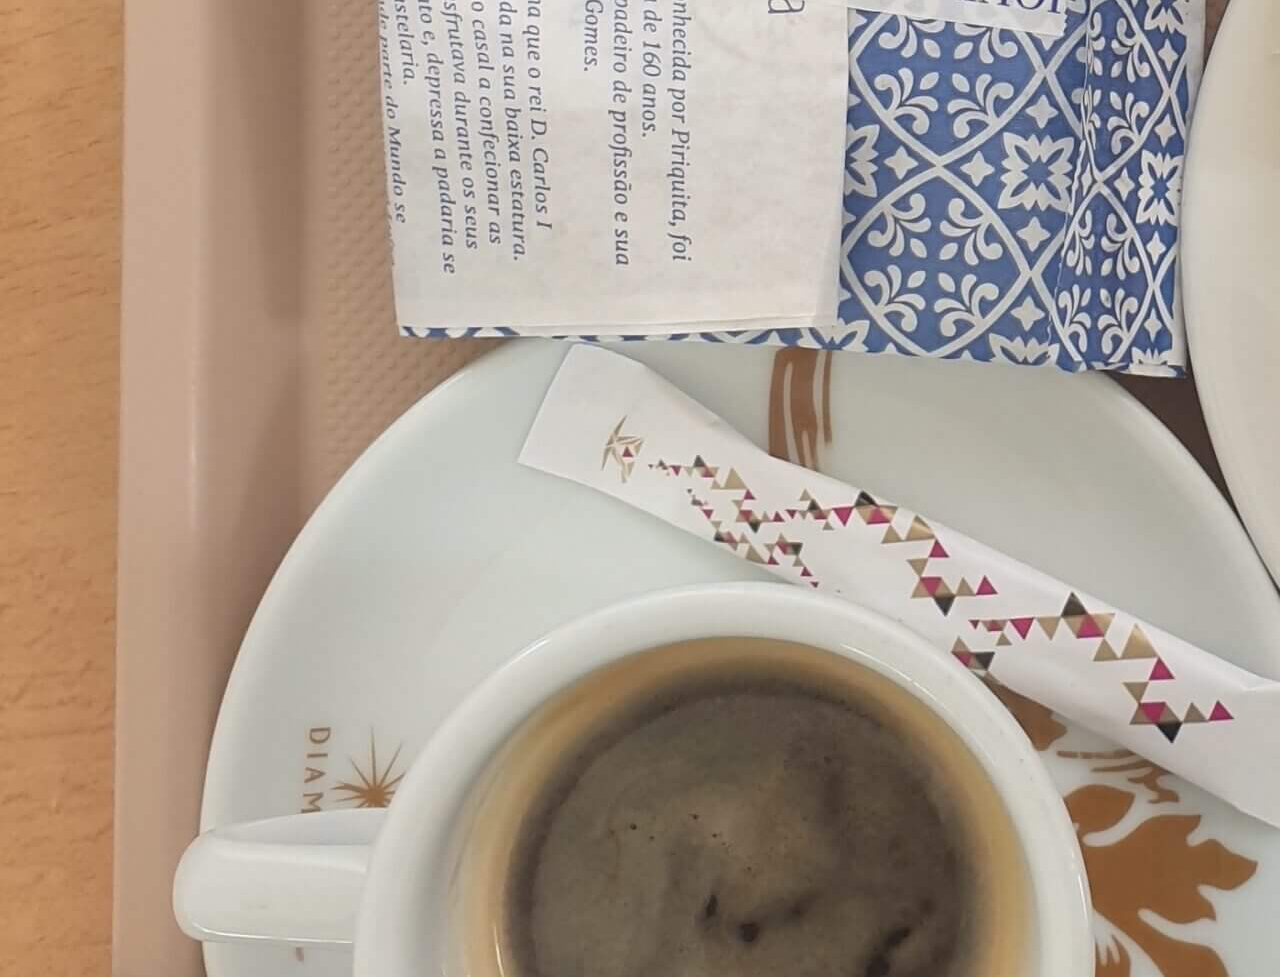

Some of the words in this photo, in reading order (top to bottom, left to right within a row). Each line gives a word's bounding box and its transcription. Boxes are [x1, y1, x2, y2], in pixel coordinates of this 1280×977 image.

[471, 1, 484, 12] o
[643, 10, 663, 32] de
[421, 31, 435, 45] e,
[472, 20, 495, 70] casal
[500, 34, 514, 57] na
[522, 25, 540, 60] que
[584, 0, 603, 71] Gomes.
[381, 38, 392, 89] parte
[528, 68, 541, 78] o
[643, 41, 661, 76] 160
[424, 53, 444, 141] depressa
[479, 78, 490, 89] a
[503, 65, 515, 99] sua
[613, 80, 632, 103] de
[386, 96, 398, 119] do
[528, 87, 547, 112] rei
[642, 84, 656, 137] anos.
[667, 88, 685, 124] por
[454, 91, 472, 170] durante
[505, 108, 523, 162] baixa
[531, 119, 547, 140] D.
[389, 127, 406, 196] Mundo
[434, 148, 446, 159] a
[478, 97, 501, 216] confecionar
[608, 110, 632, 204] profissão
[462, 177, 475, 198] os
[533, 148, 551, 214] Carlos
[666, 128, 691, 226] Piriquita,
[395, 203, 405, 223] se
[432, 166, 457, 246] padaria
[510, 169, 525, 260] estatura.
[614, 212, 628, 222] e
[464, 205, 477, 249] seus
[489, 222, 501, 244] as
[537, 221, 552, 229] I
[443, 253, 455, 273] se
[615, 229, 629, 265] sua
[667, 233, 692, 261] foi
